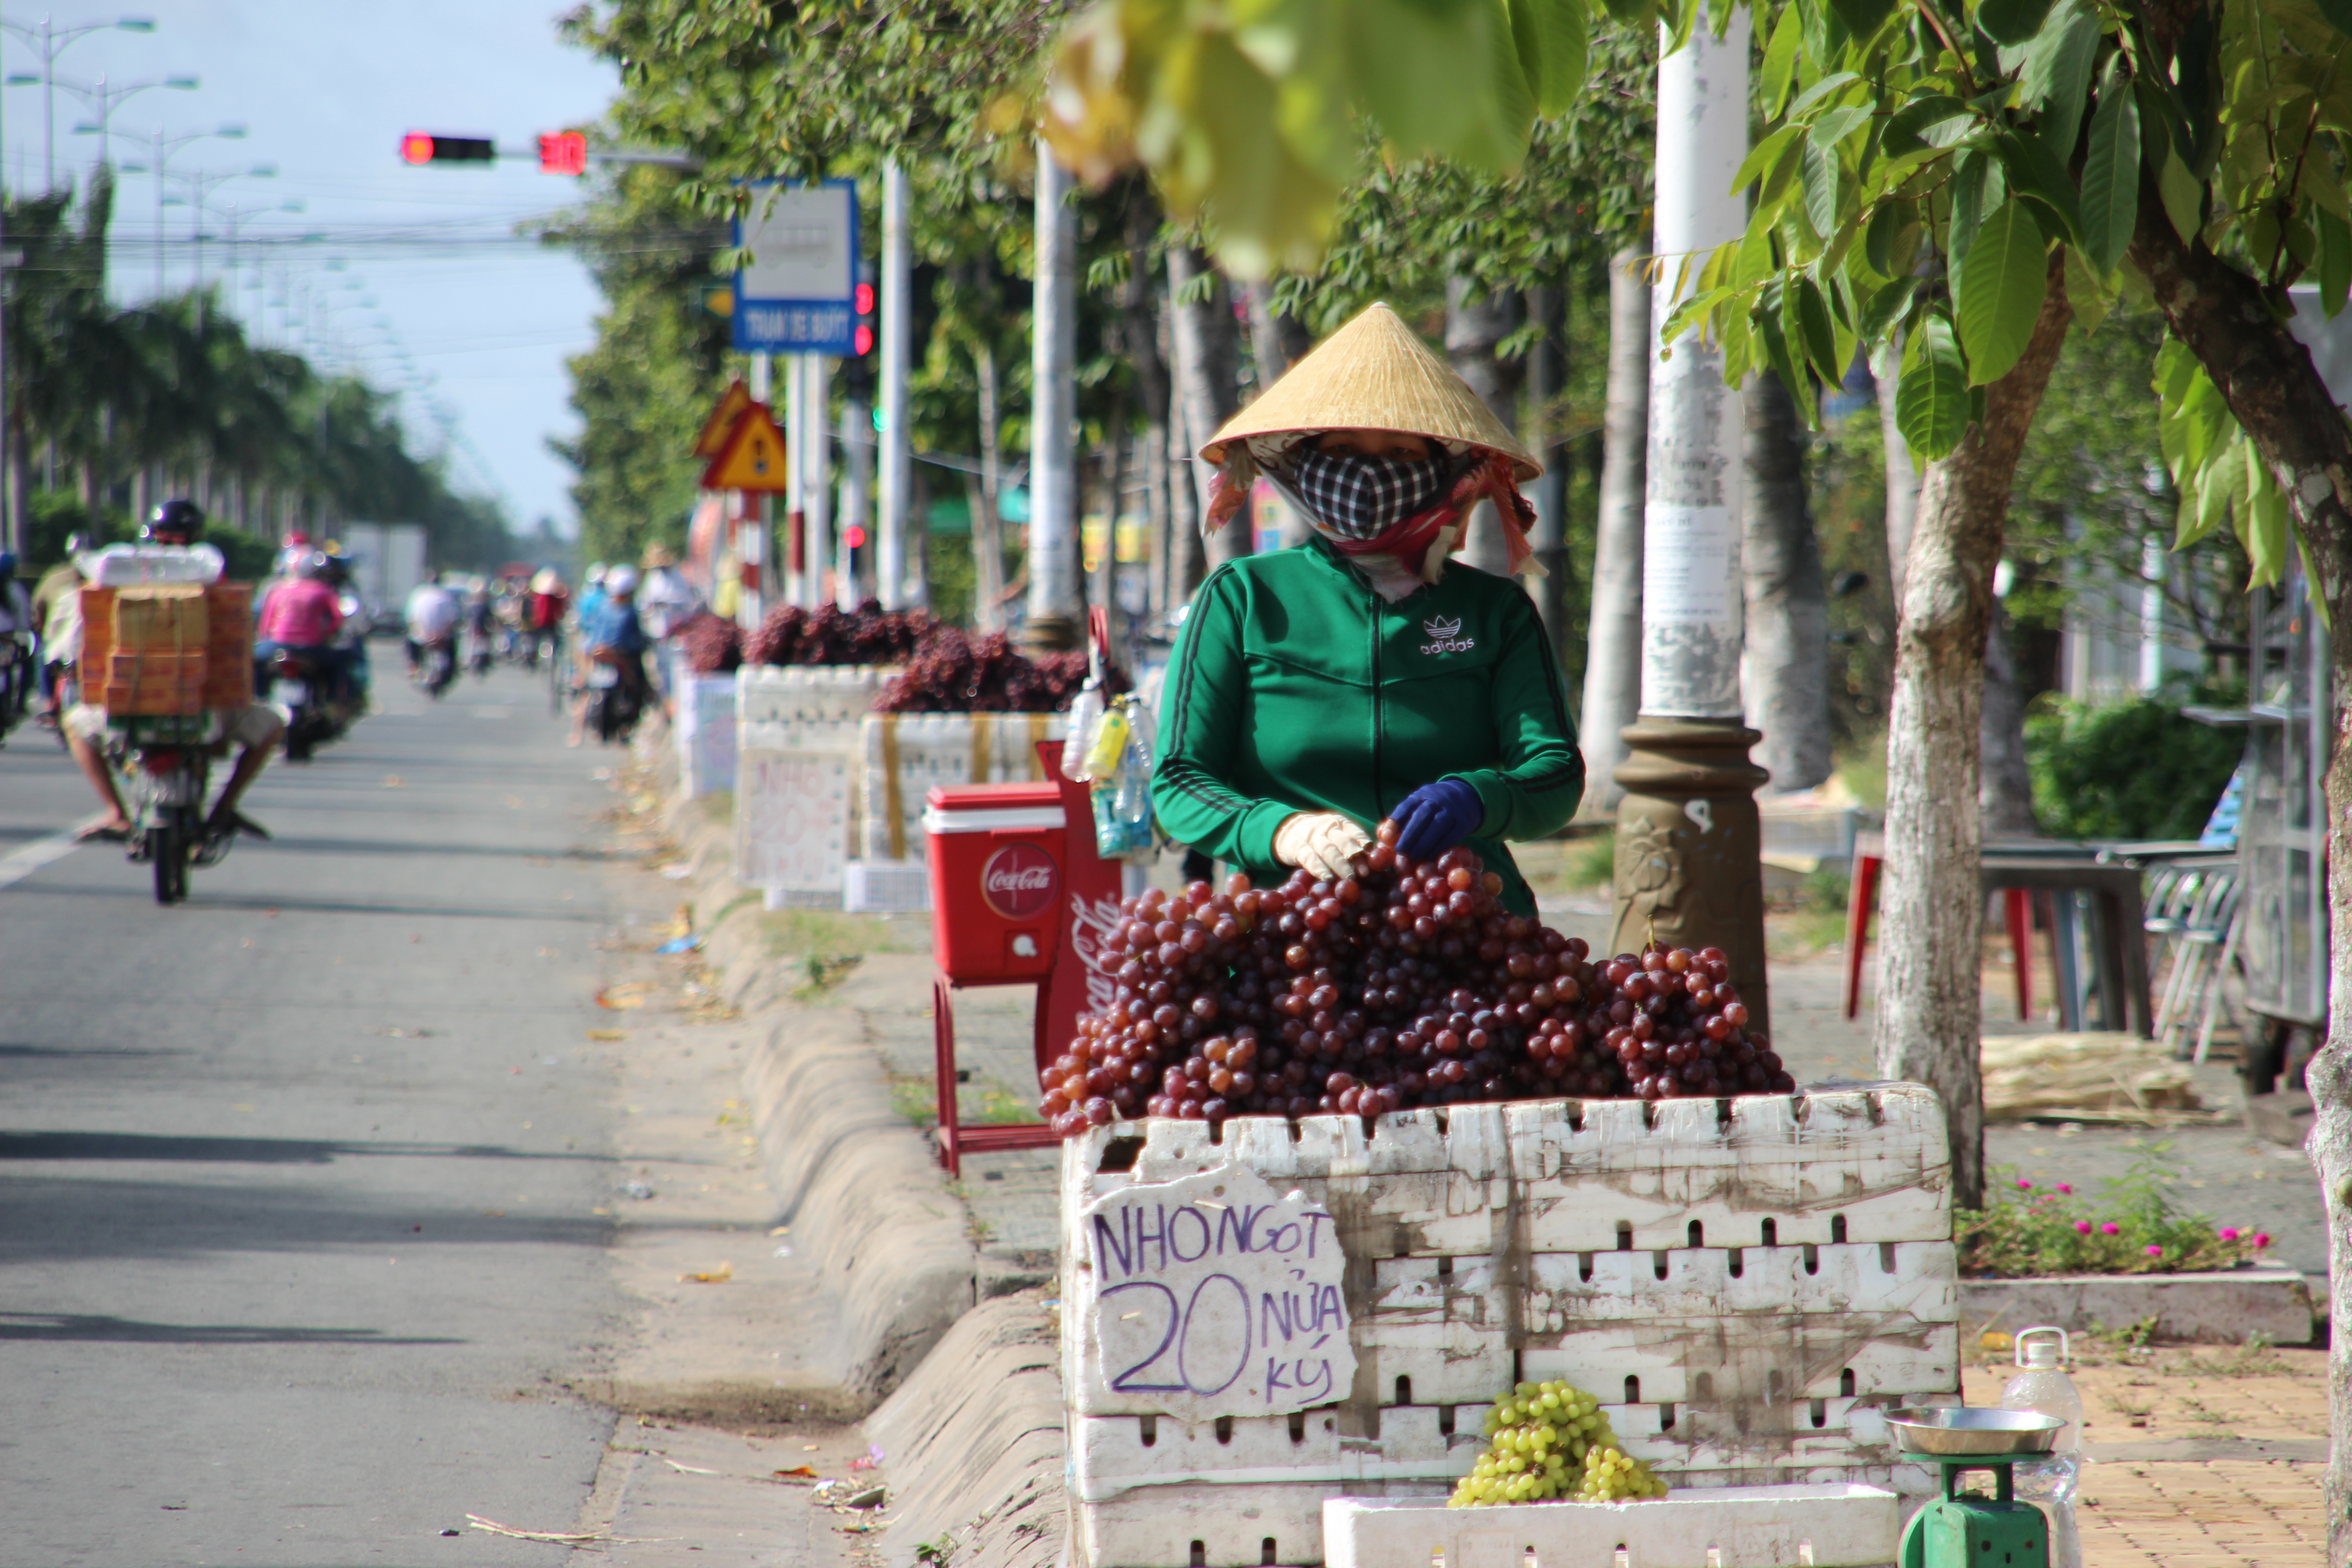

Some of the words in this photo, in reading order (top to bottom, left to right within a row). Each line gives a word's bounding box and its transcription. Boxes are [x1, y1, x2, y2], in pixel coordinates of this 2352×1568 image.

[1420, 638, 1475, 655] adidas
[1093, 1204, 1210, 1281] NHO
[1100, 1274, 1252, 1397] 20
